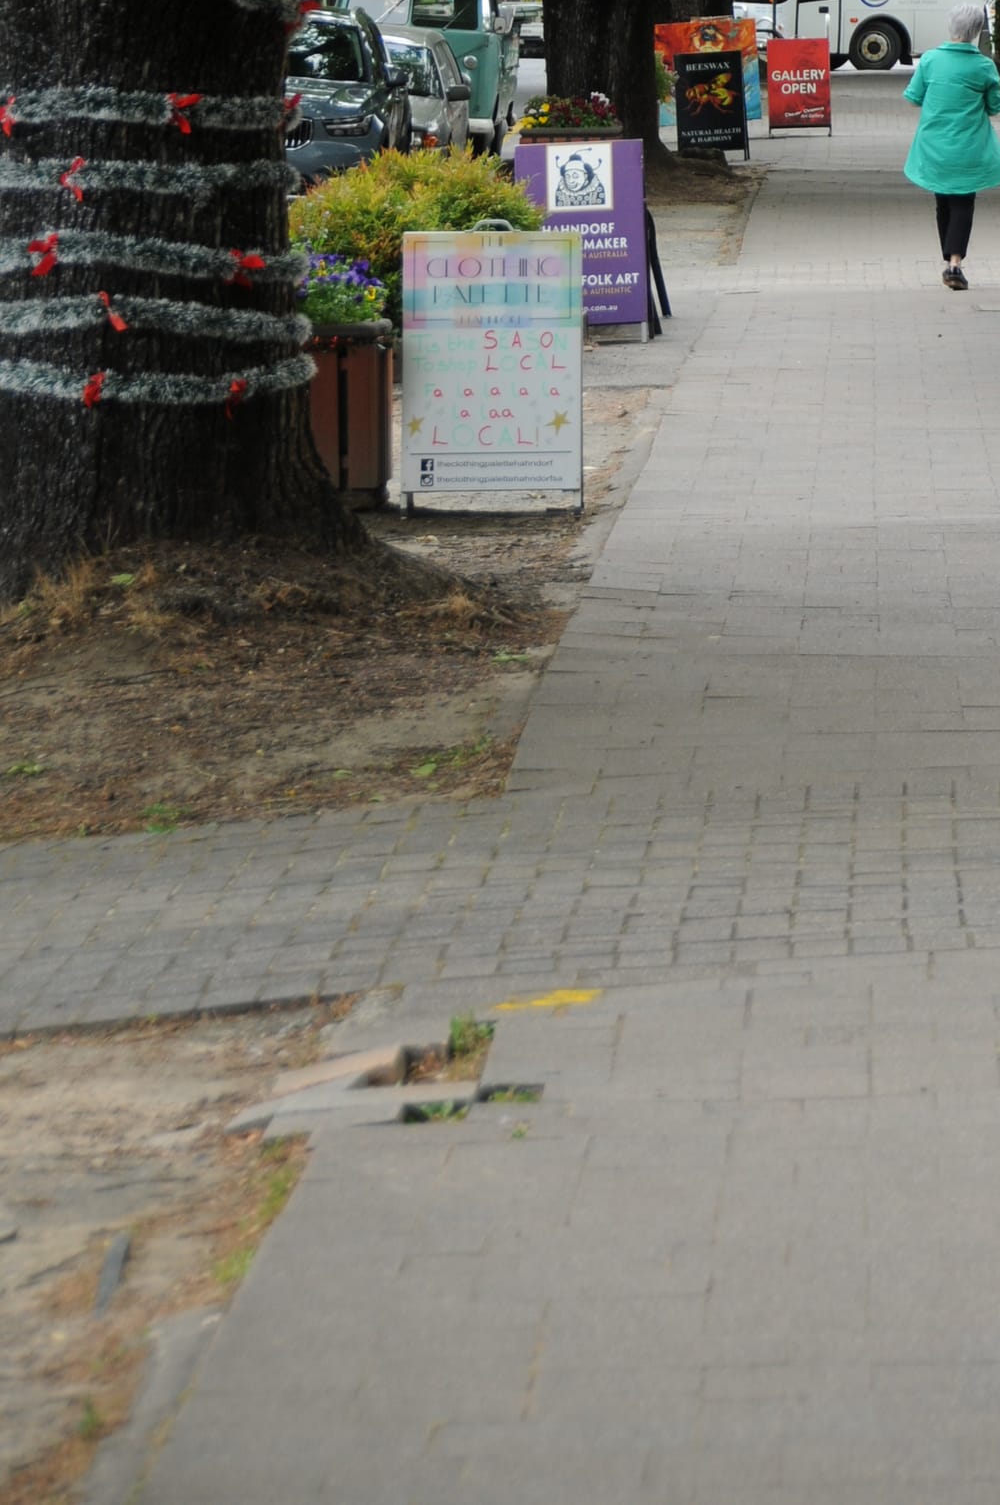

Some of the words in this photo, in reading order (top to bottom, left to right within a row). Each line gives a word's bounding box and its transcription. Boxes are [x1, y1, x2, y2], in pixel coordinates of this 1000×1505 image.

[686, 61, 730, 72] BEESWAX
[771, 68, 826, 81] GALLERY
[781, 82, 817, 95] OPEN
[681, 128, 712, 137] NATURAL
[713, 127, 742, 135] HEALTH
[697, 135, 732, 143] HARMONY
[541, 222, 615, 235] HAHNDORF
[588, 251, 628, 259] AUSTRALIA
[426, 257, 560, 278] CLOTHING
[581, 273, 613, 286] FOLK
[615, 272, 640, 284] ART
[432, 284, 552, 304] PALETTE
[590, 286, 632, 295] AUTHENTIC
[483, 330, 568, 351] SEASON
[485, 352, 568, 372] LOCAL
[431, 423, 541, 447] LOCAL!
